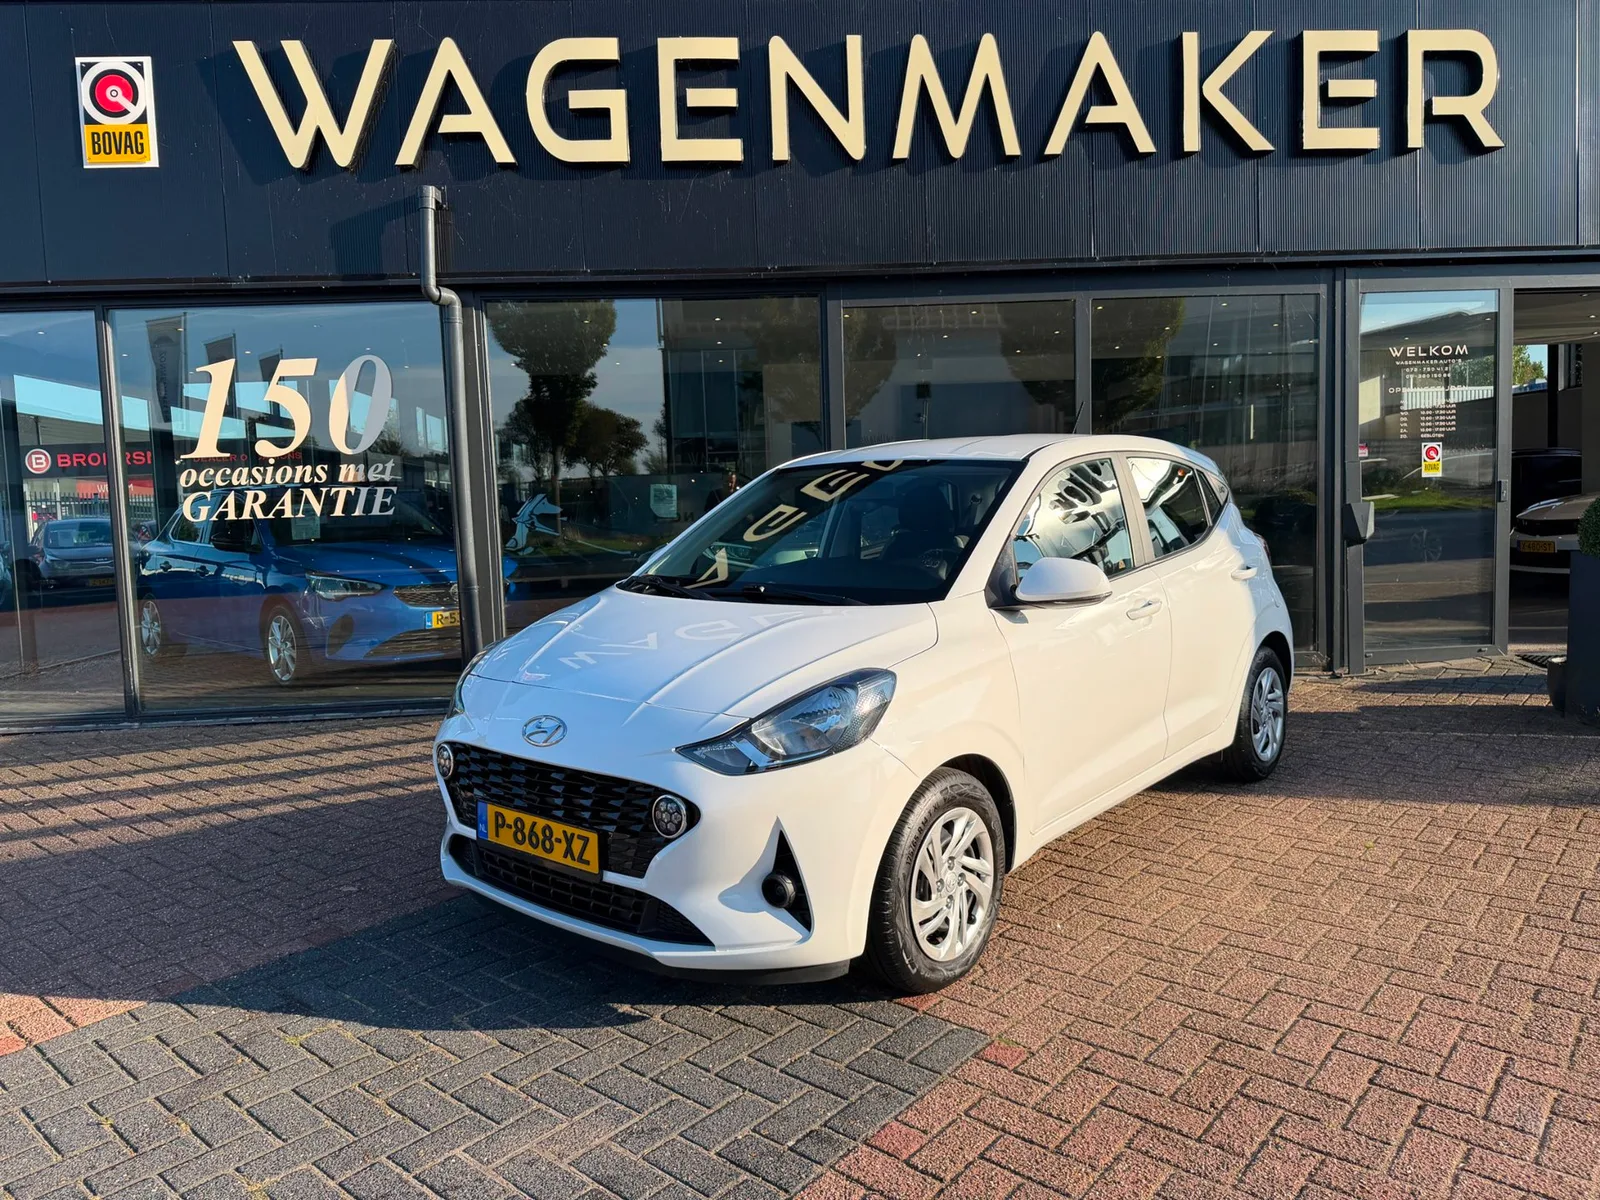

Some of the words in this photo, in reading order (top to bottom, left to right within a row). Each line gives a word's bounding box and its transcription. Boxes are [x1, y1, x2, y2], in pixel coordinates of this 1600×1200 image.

[232, 30, 1506, 168] WAGENMAKER
[90, 130, 145, 157] BOVAG
[1389, 344, 1468, 357] WELKOM
[180, 354, 393, 459] 150
[180, 458, 328, 488] occasions
[338, 459, 396, 484] met
[1424, 463, 1440, 471] BOVAG
[182, 486, 398, 523] GARANTIE
[436, 611, 460, 625] R-5
[494, 810, 591, 866] P-868-XZ
